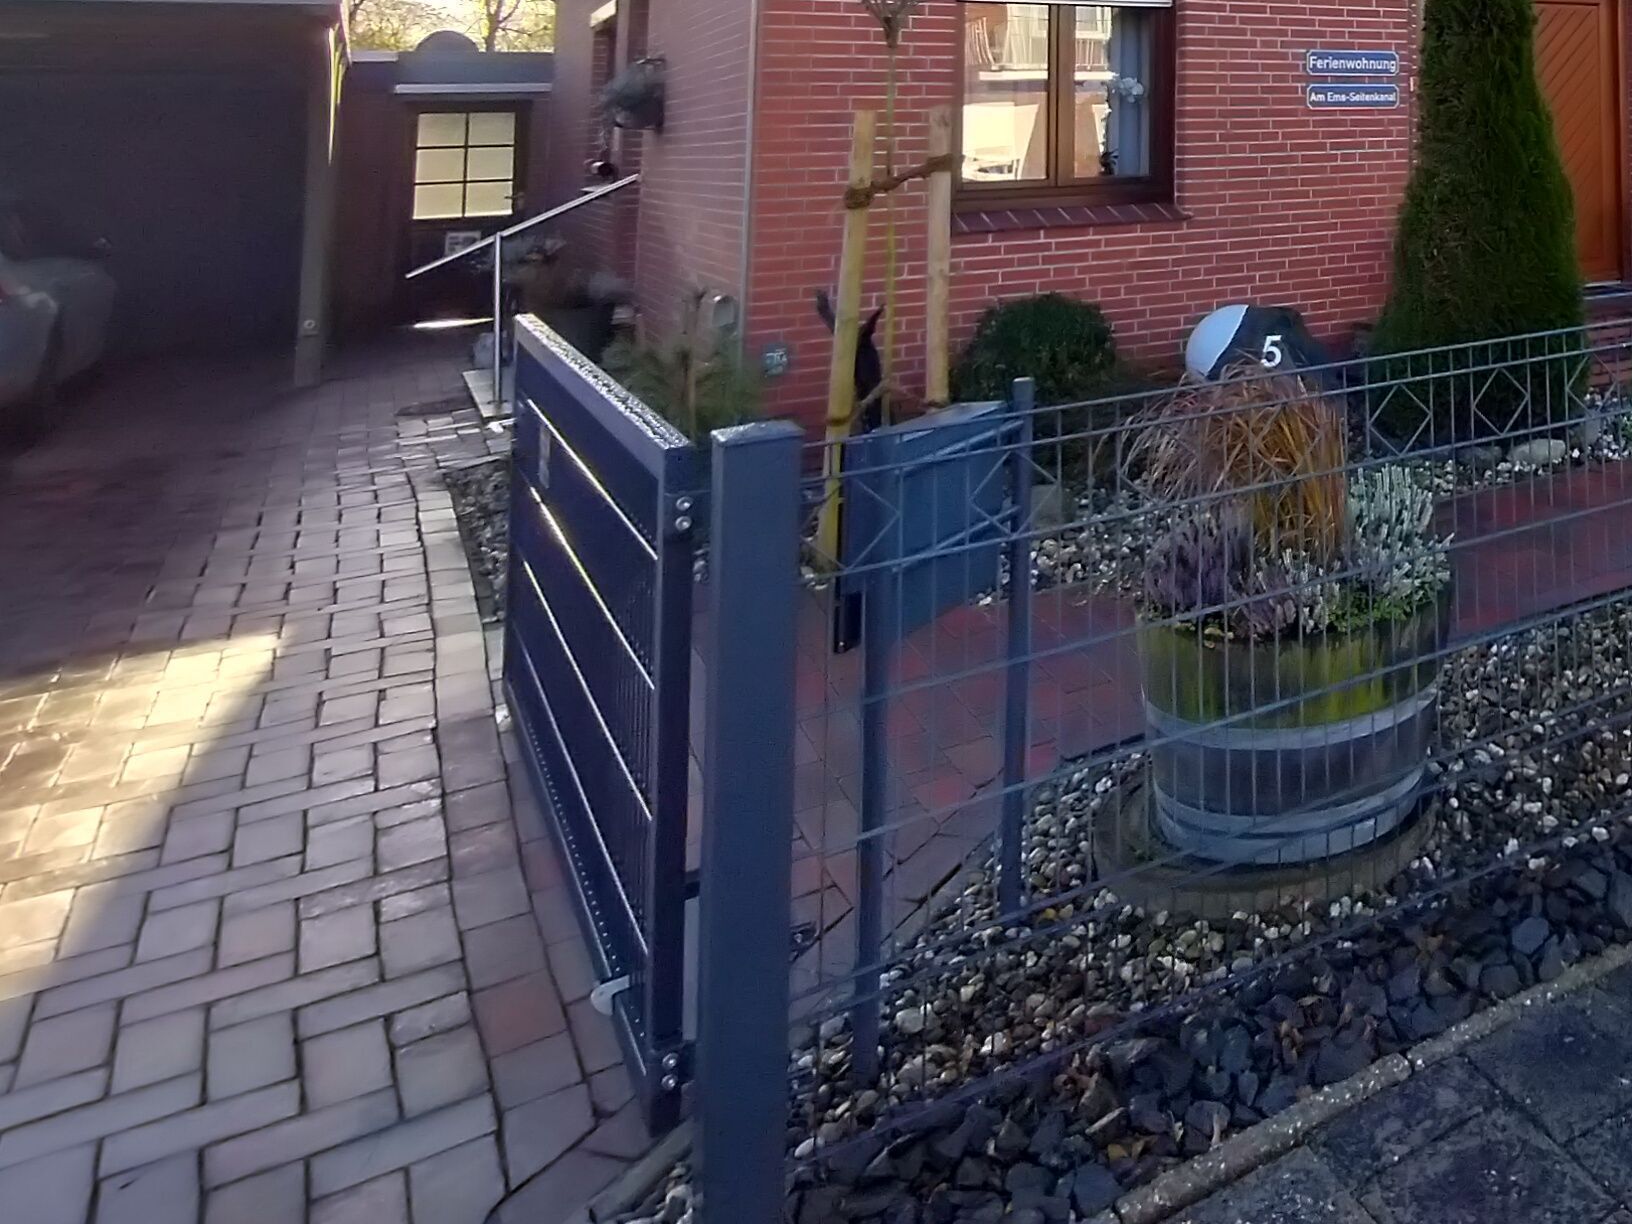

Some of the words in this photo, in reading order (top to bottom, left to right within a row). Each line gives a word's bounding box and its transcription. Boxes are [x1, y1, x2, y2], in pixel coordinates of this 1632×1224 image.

[1309, 56, 1396, 72] Ferienwohnung
[1309, 92, 1325, 102] Am
[1327, 92, 1396, 102] Ems-Seitenkanal
[1260, 335, 1282, 367] 5
